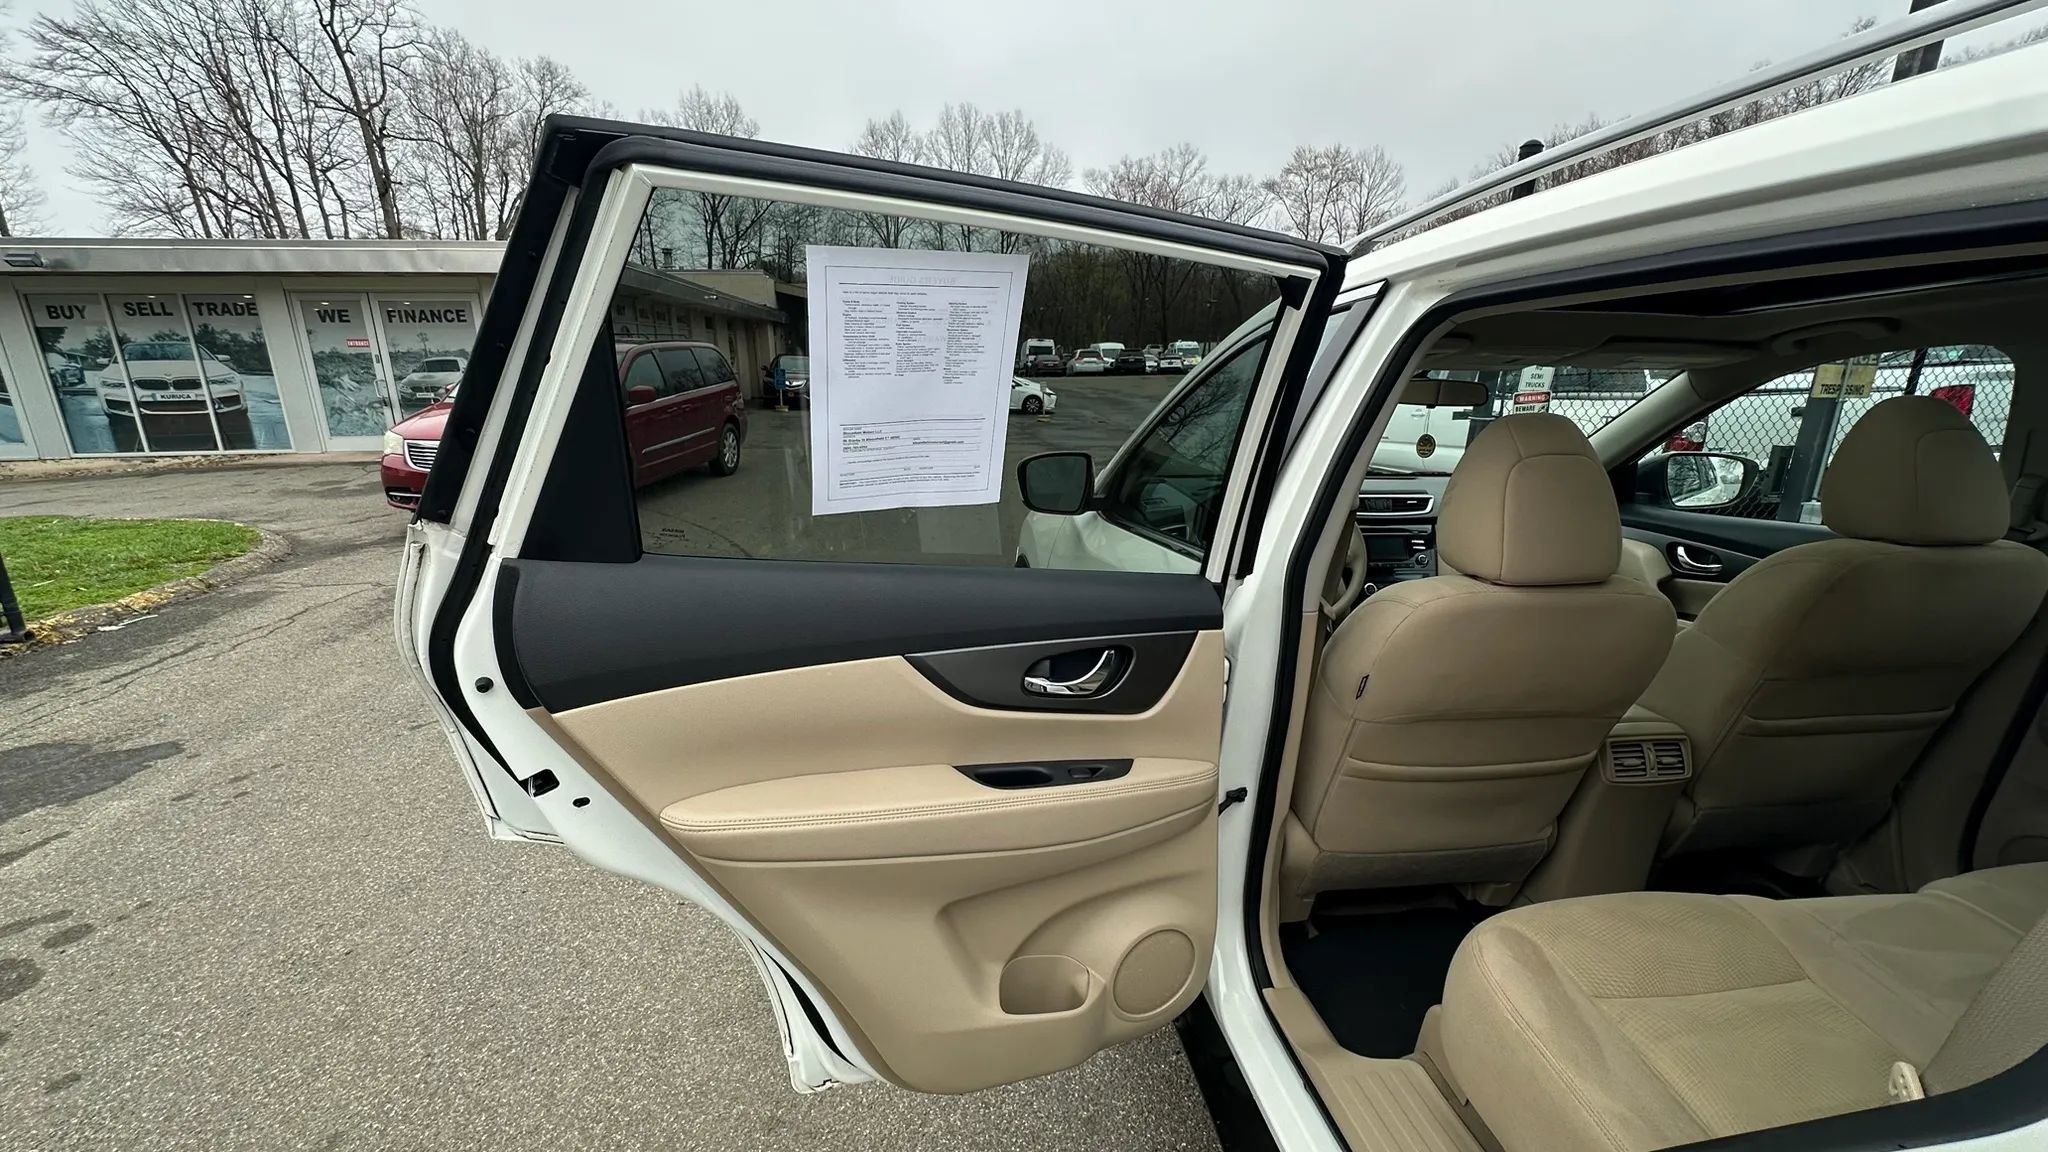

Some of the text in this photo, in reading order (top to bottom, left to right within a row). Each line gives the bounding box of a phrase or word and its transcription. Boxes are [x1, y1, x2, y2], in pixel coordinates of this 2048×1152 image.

[45, 302, 259, 320] BUY SELL TRADE
[317, 309, 468, 323] WE FINANCE
[1820, 384, 1865, 395] TRESPSSING
[1519, 394, 1546, 402] WARNING
